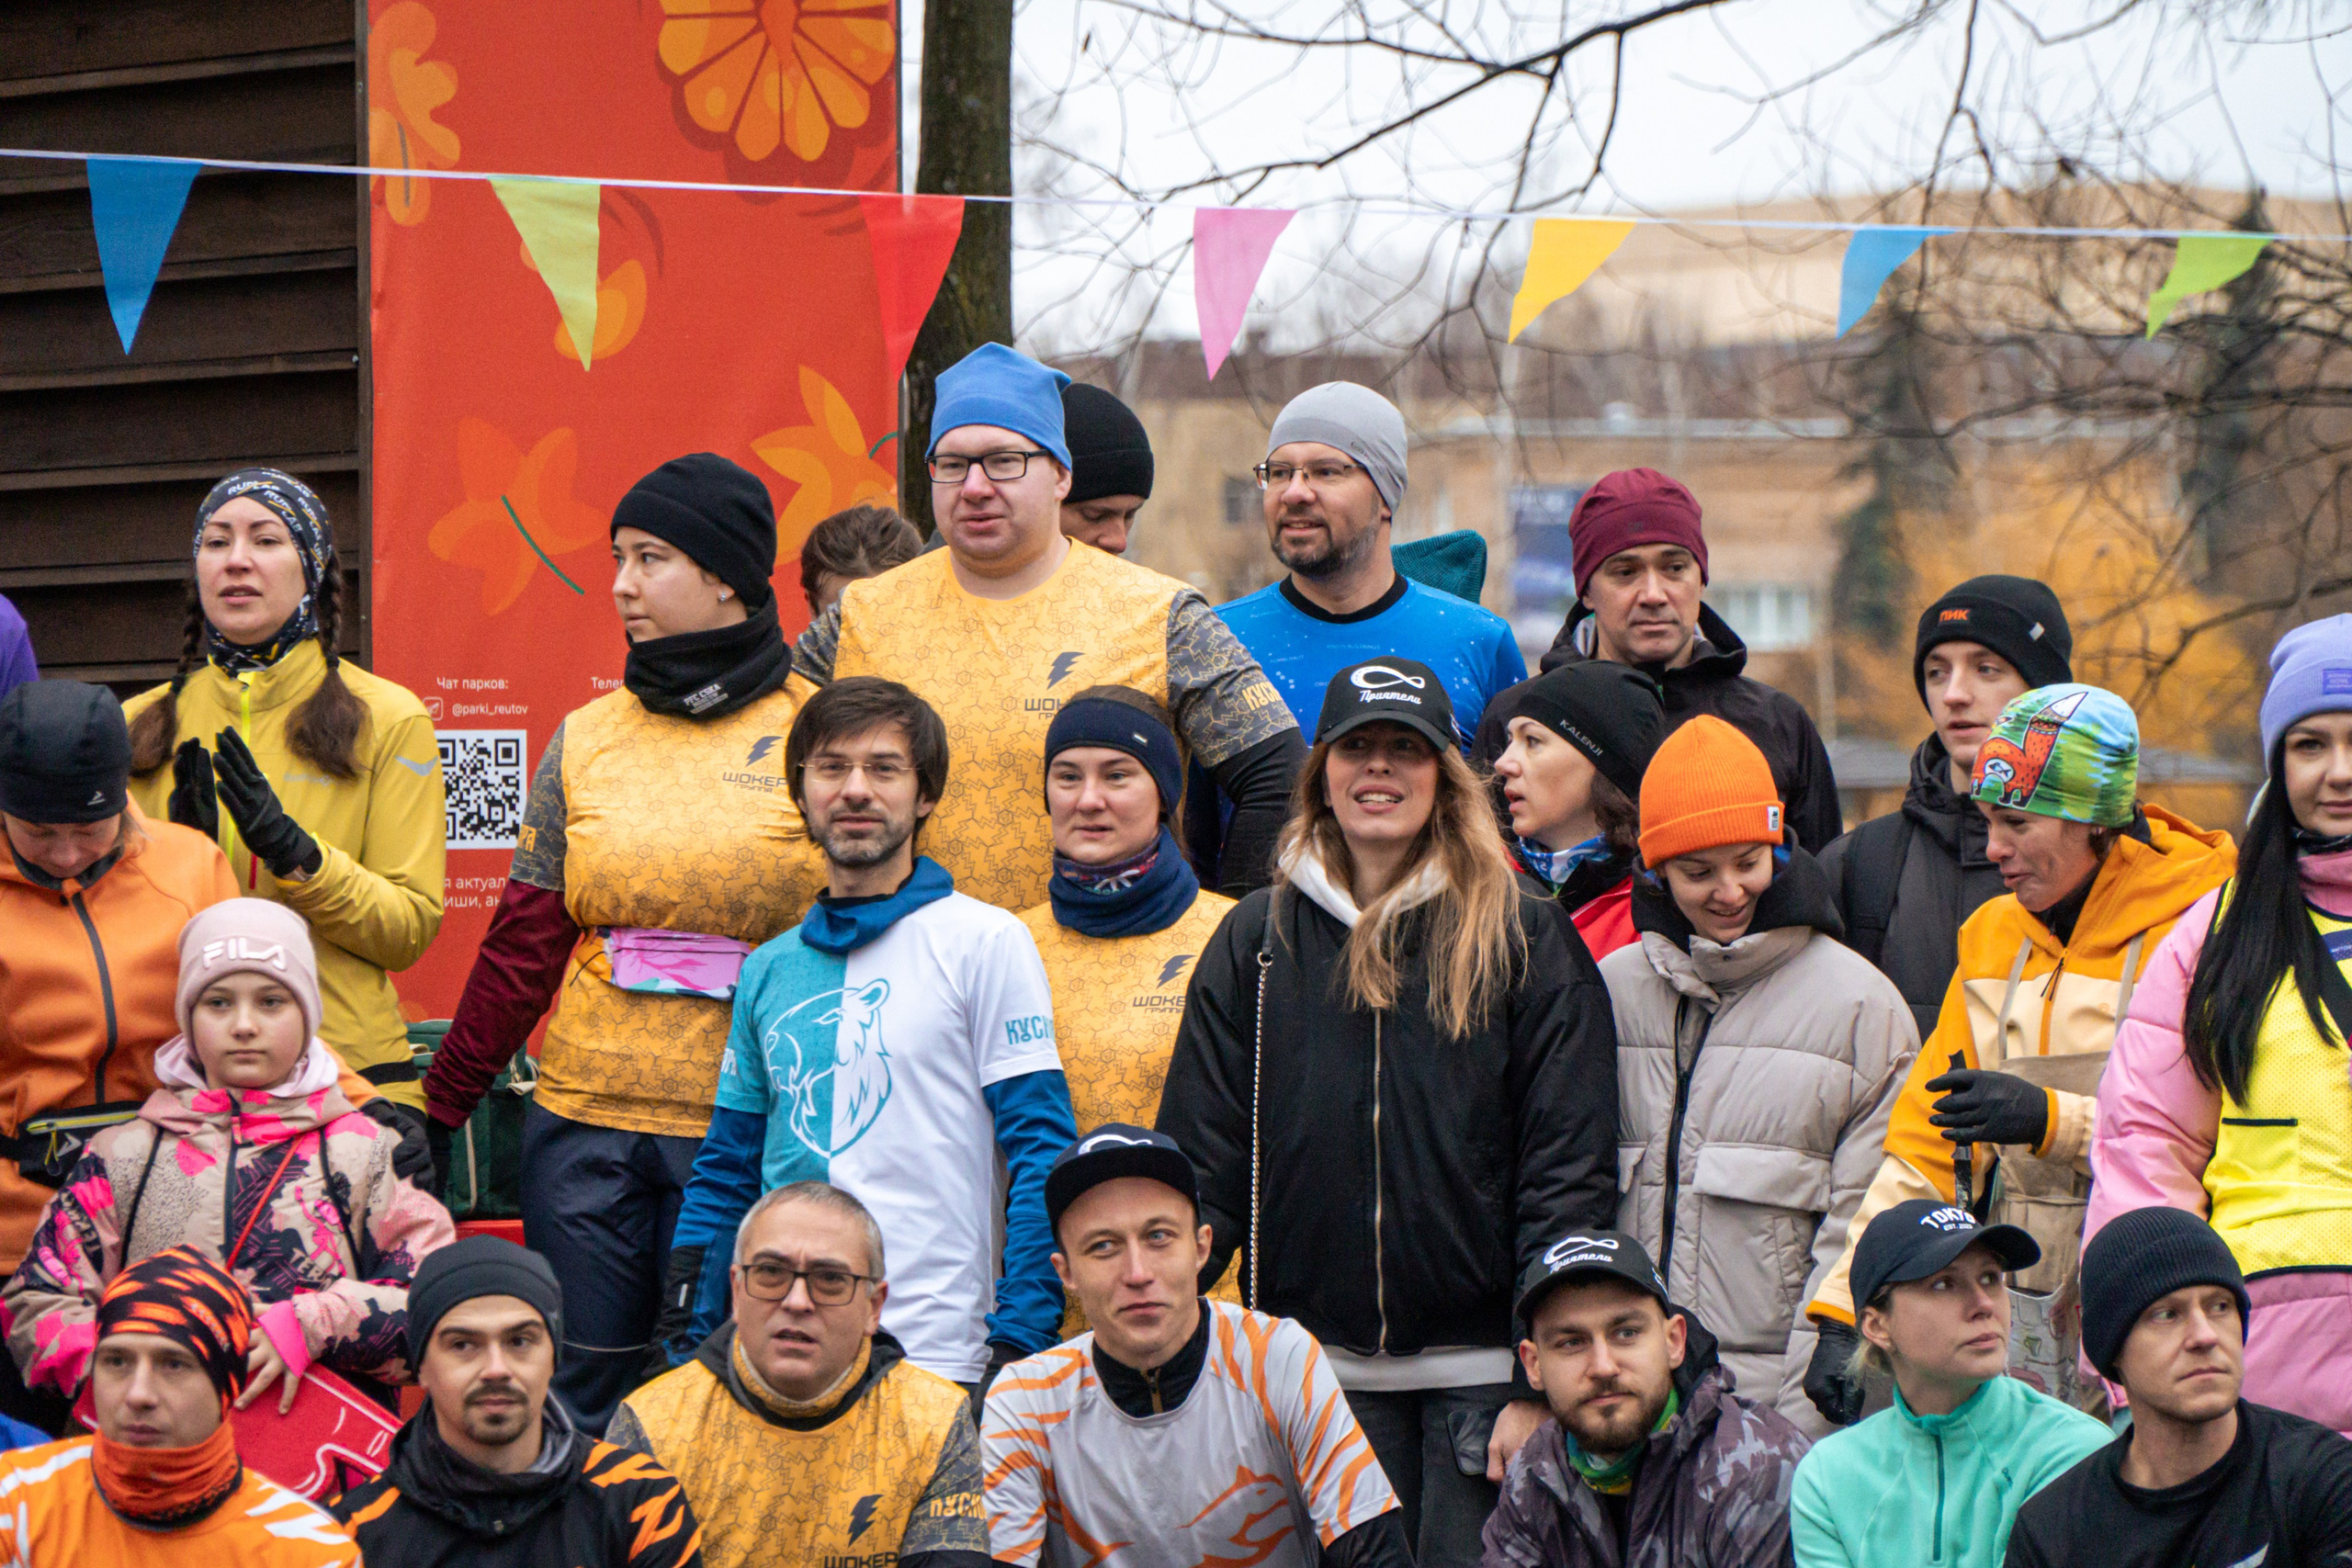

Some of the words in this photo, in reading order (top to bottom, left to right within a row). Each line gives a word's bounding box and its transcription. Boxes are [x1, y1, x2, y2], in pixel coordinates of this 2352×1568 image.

[1939, 608, 1970, 622] ПИК
[436, 676, 458, 690] Чат
[462, 678, 509, 692] парков:
[1360, 689, 1422, 705] Приятели
[451, 703, 528, 717] @parki_reutov
[1559, 719, 1603, 757] KALENJI
[722, 772, 788, 787] ШОКЕР
[734, 784, 774, 793] ГРУППА
[203, 937, 286, 971] FILA
[1132, 995, 1186, 1007] ШОКЕ
[1919, 1207, 1976, 1229] TOKYO
